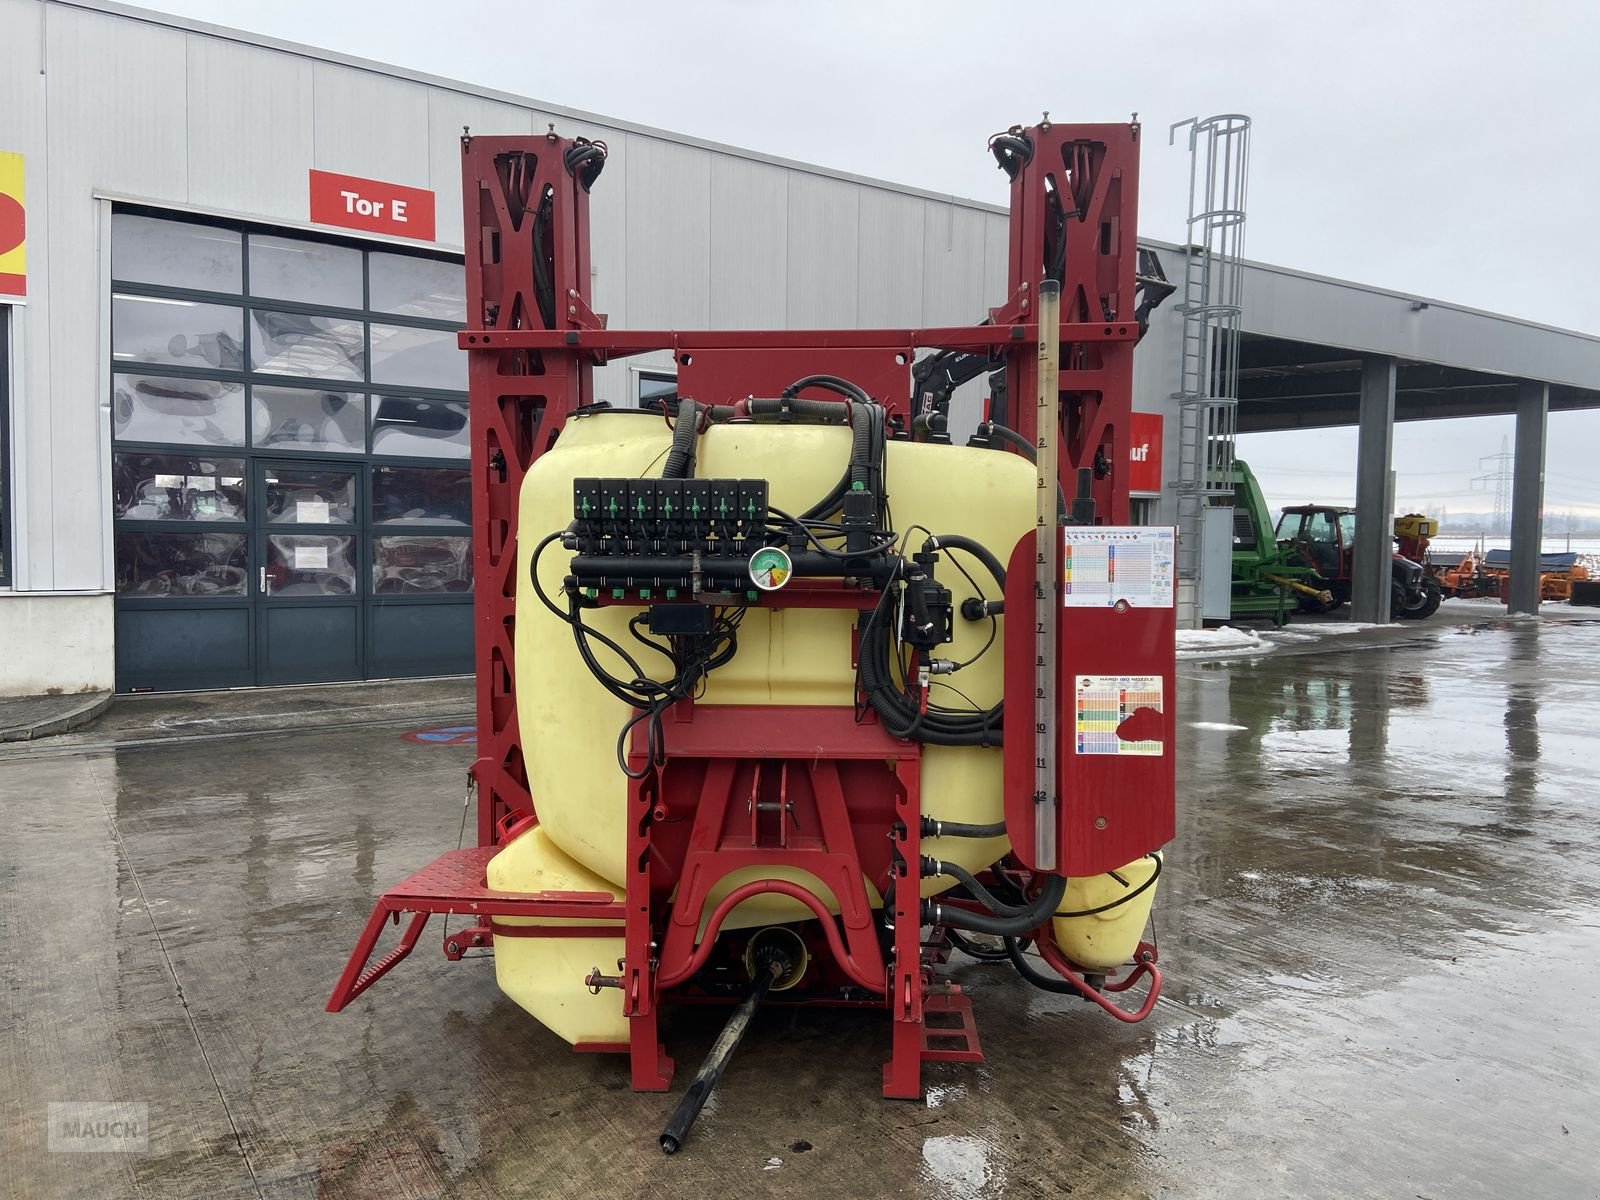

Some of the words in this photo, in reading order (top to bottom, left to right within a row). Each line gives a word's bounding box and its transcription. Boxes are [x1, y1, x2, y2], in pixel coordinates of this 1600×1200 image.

[340, 190, 384, 218] Tor
[391, 199, 408, 222] E
[1039, 396, 1044, 405] 1
[1039, 437, 1045, 446] 2
[1129, 443, 1149, 461] uf
[1038, 477, 1044, 486] 3
[1037, 515, 1043, 524] 4
[1037, 553, 1043, 561] 5
[1037, 588, 1043, 597] 6
[1037, 622, 1043, 631] 7
[1037, 655, 1043, 664] 8
[1037, 687, 1043, 696] 9
[1036, 723, 1046, 731] 10
[1036, 758, 1045, 766] 11
[1036, 790, 1047, 799] 12
